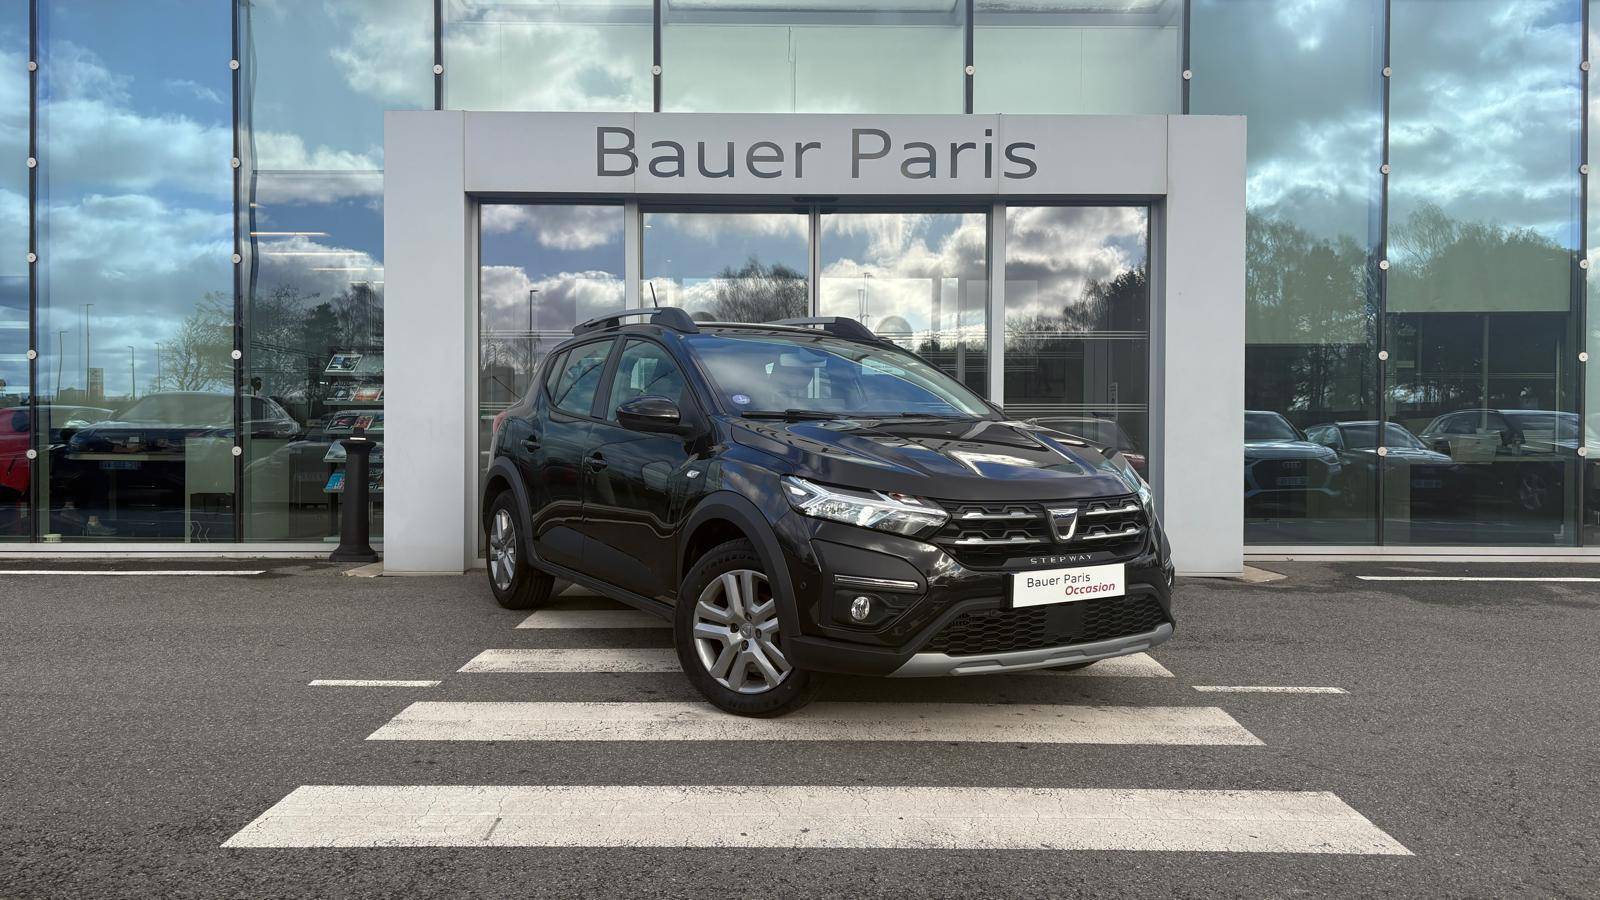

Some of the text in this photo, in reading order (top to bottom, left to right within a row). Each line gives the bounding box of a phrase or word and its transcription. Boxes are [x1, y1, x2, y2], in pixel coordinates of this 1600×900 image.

[596, 126, 1037, 179] Bauer Paris
[1030, 554, 1093, 564] STEPWAY
[1027, 573, 1091, 587] Bauer Paris
[1065, 582, 1115, 595] Occasion
